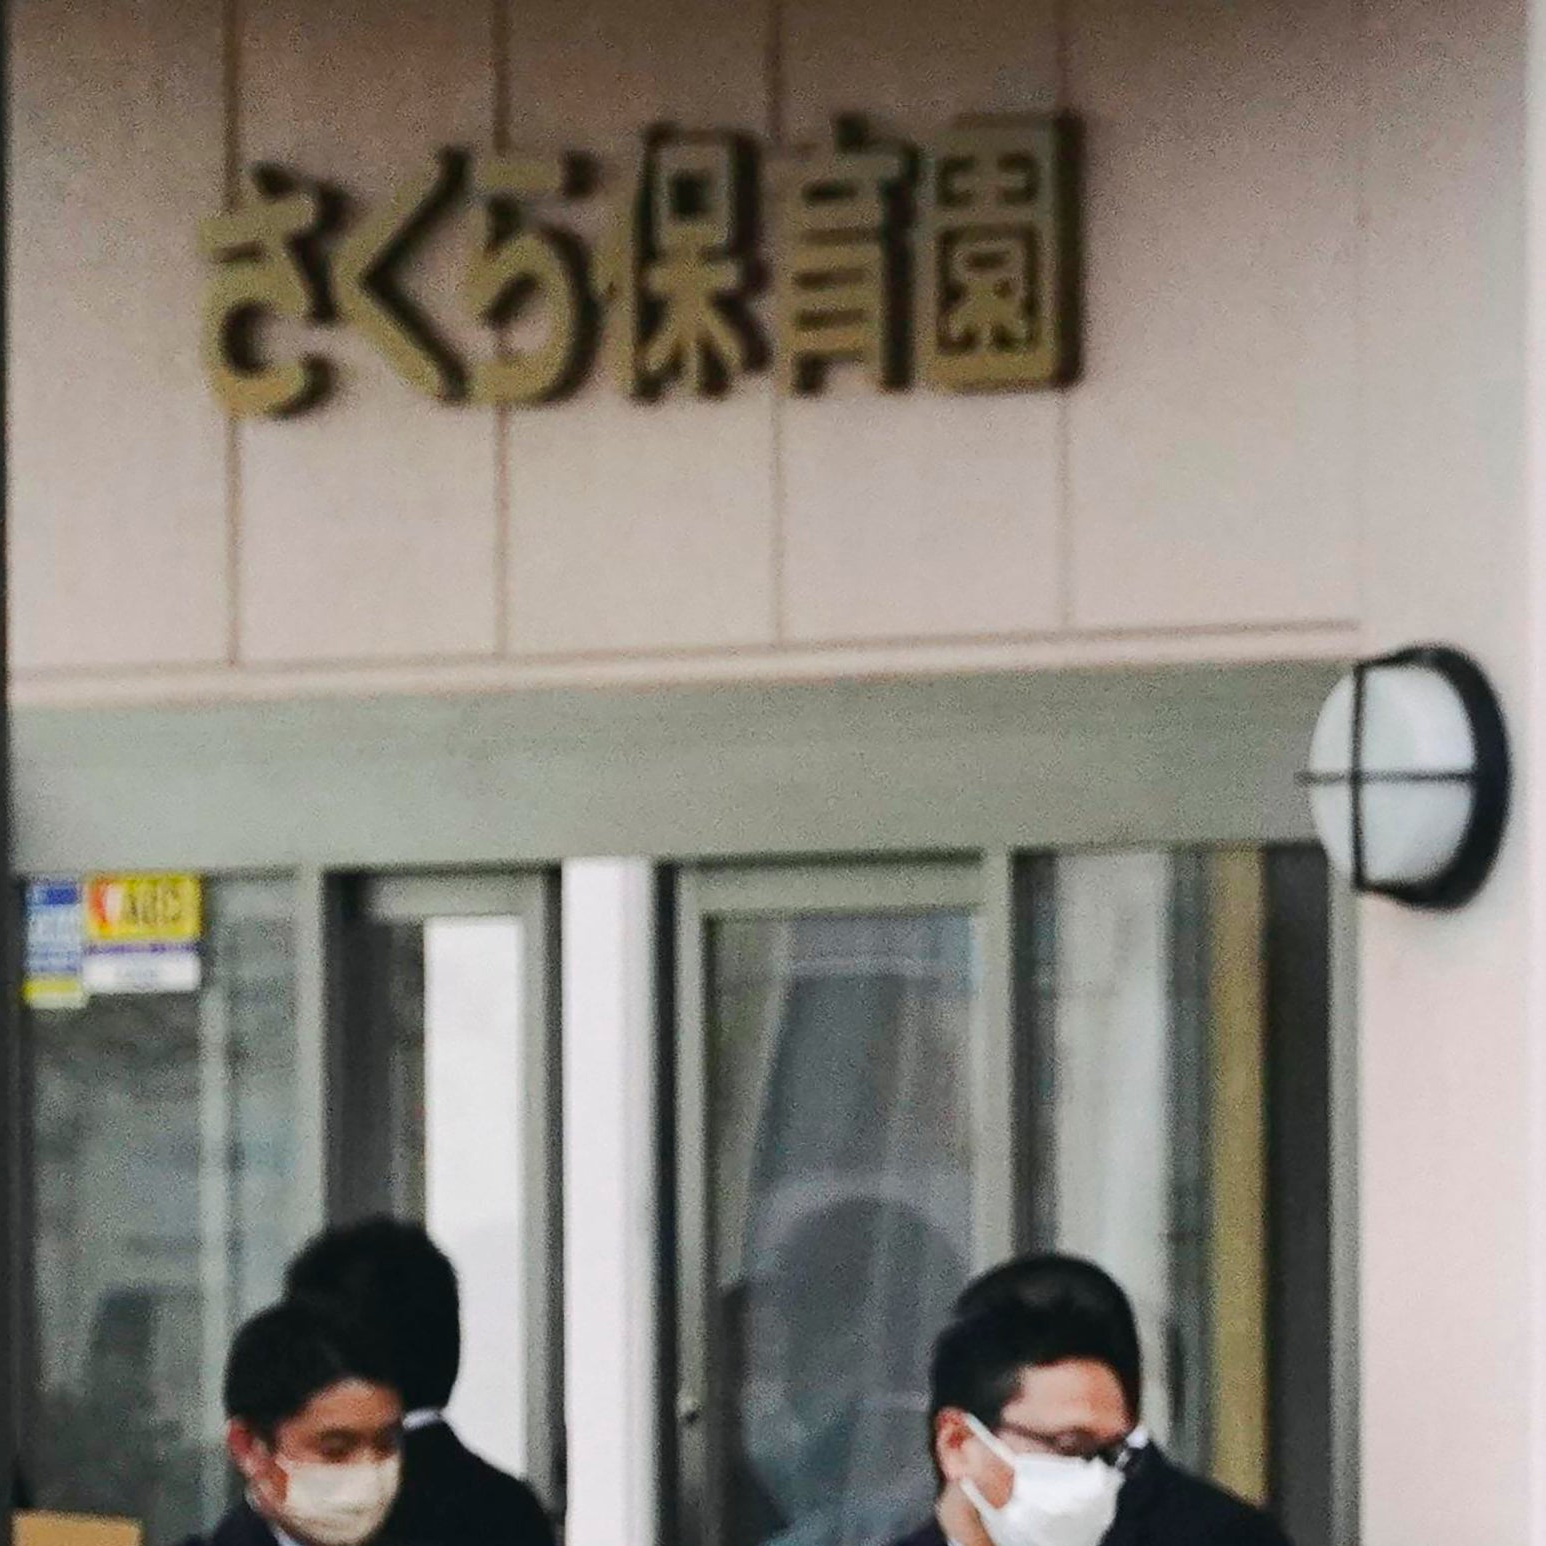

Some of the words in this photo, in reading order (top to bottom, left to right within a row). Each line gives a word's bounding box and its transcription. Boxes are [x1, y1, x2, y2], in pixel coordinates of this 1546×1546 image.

[200, 110, 1083, 418] さくら保育園
